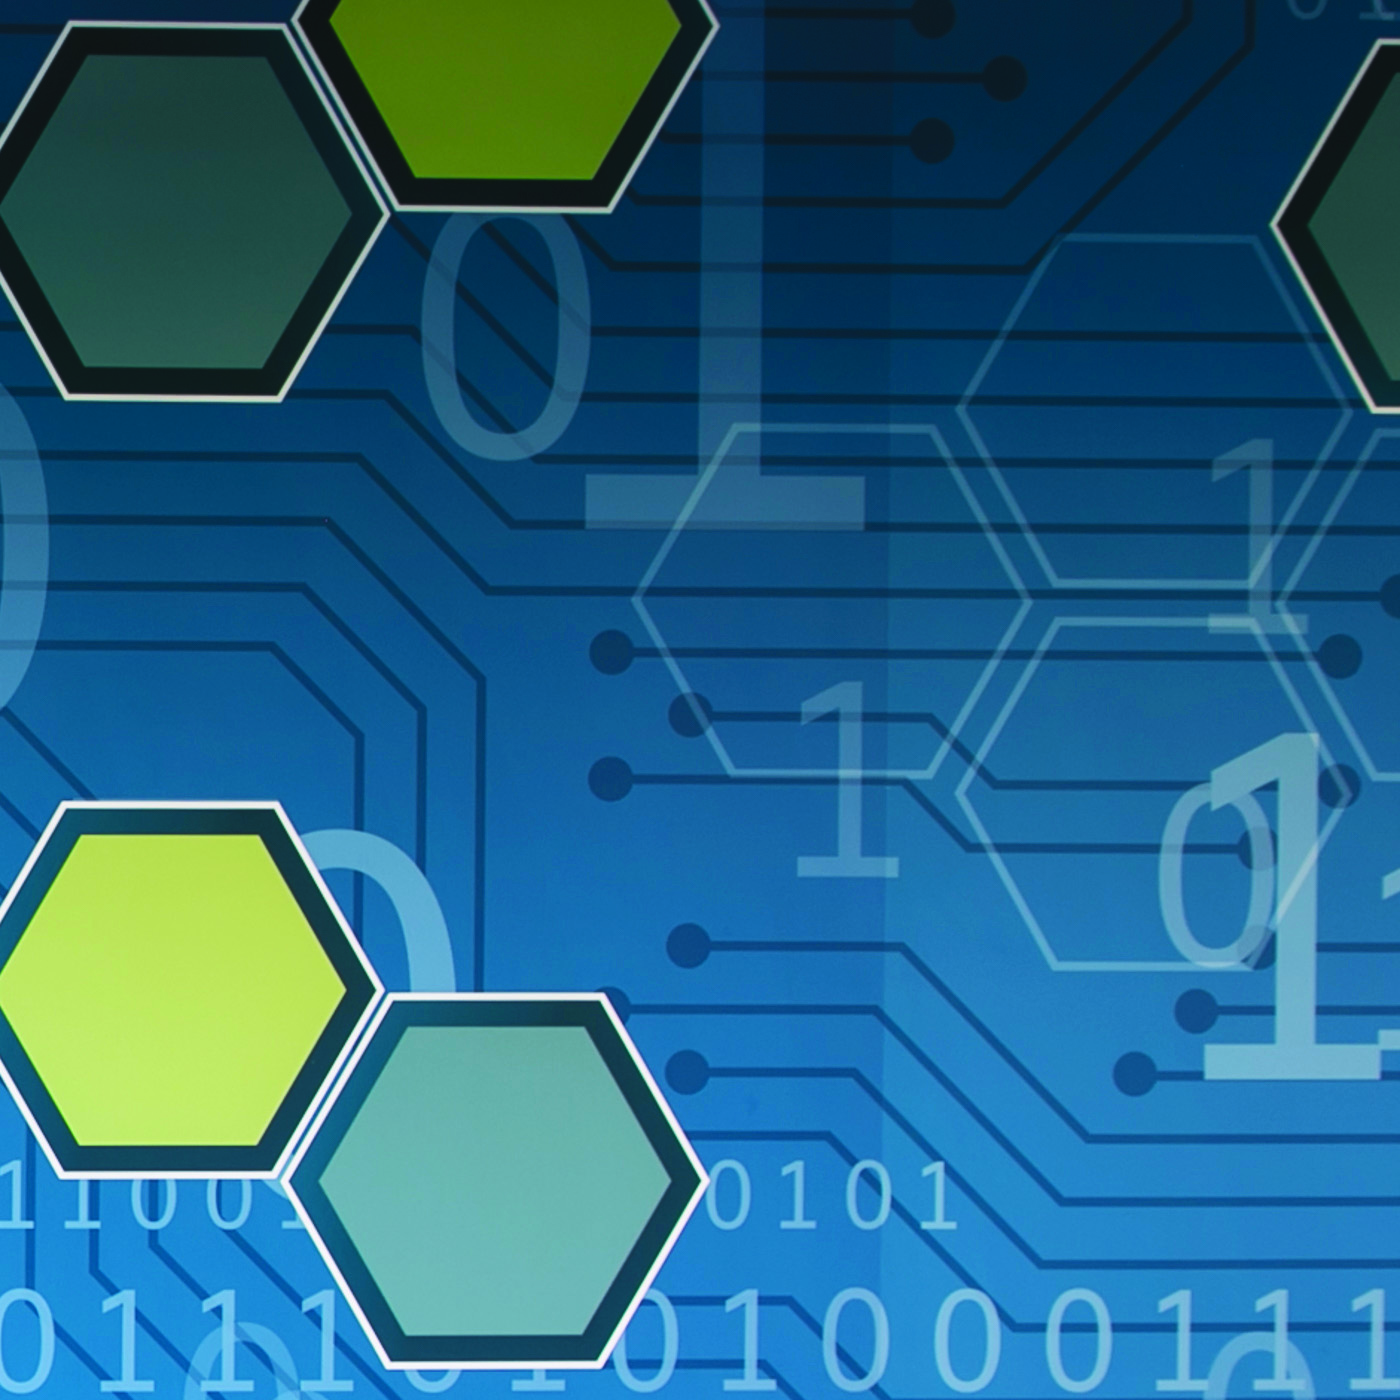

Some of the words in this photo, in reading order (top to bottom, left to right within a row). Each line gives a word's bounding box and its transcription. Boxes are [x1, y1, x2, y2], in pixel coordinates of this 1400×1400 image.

[421, 213, 591, 461] 0
[1208, 438, 1309, 635] 1
[797, 680, 900, 878] 1
[1159, 781, 1276, 969] 0
[1204, 733, 1382, 1080] 1
